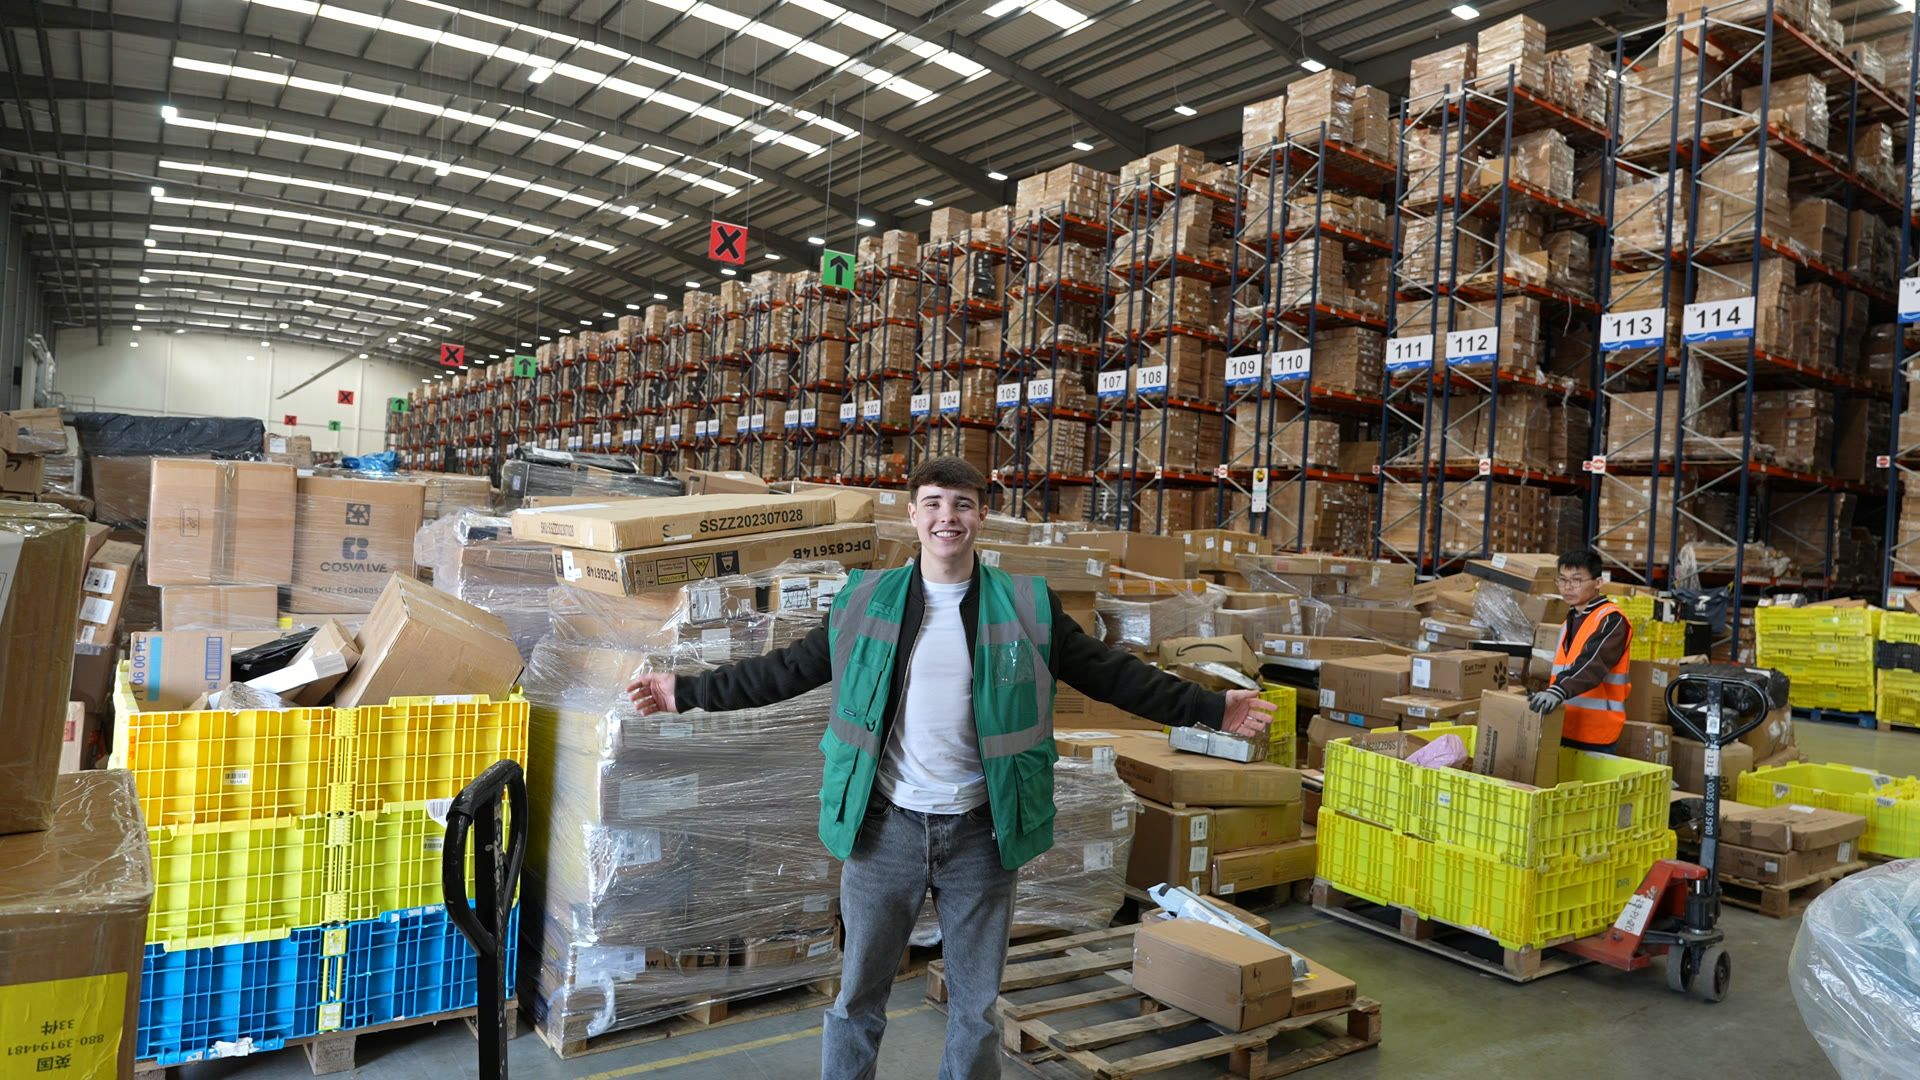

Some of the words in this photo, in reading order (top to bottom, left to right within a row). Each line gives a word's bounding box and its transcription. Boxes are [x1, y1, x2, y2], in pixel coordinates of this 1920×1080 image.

[1696, 306, 1741, 328] 114
[1612, 316, 1652, 337] 113
[1395, 341, 1422, 359] 111
[1455, 334, 1488, 353] 112
[1232, 360, 1255, 376] 109
[1278, 354, 1303, 371] 110
[1103, 375, 1122, 389] 107
[1142, 370, 1162, 384] 108
[1001, 387, 1017, 400] 105
[1032, 383, 1048, 396] 106
[913, 398, 927, 409] 103
[943, 394, 957, 406] 104
[843, 406, 854, 417] 101
[867, 403, 878, 414] 102
[699, 508, 804, 533] SSZZ202307028
[793, 539, 872, 560] DFC83614B
[320, 561, 389, 573] COSVALVE
[586, 565, 619, 583] DFC83614B
[133, 655, 146, 669] 00
[1464, 664, 1474, 672] Cat
[132, 671, 145, 686] 06
[7, 1034, 105, 1057] 880-39194481
[36, 1053, 72, 1073] 英国
